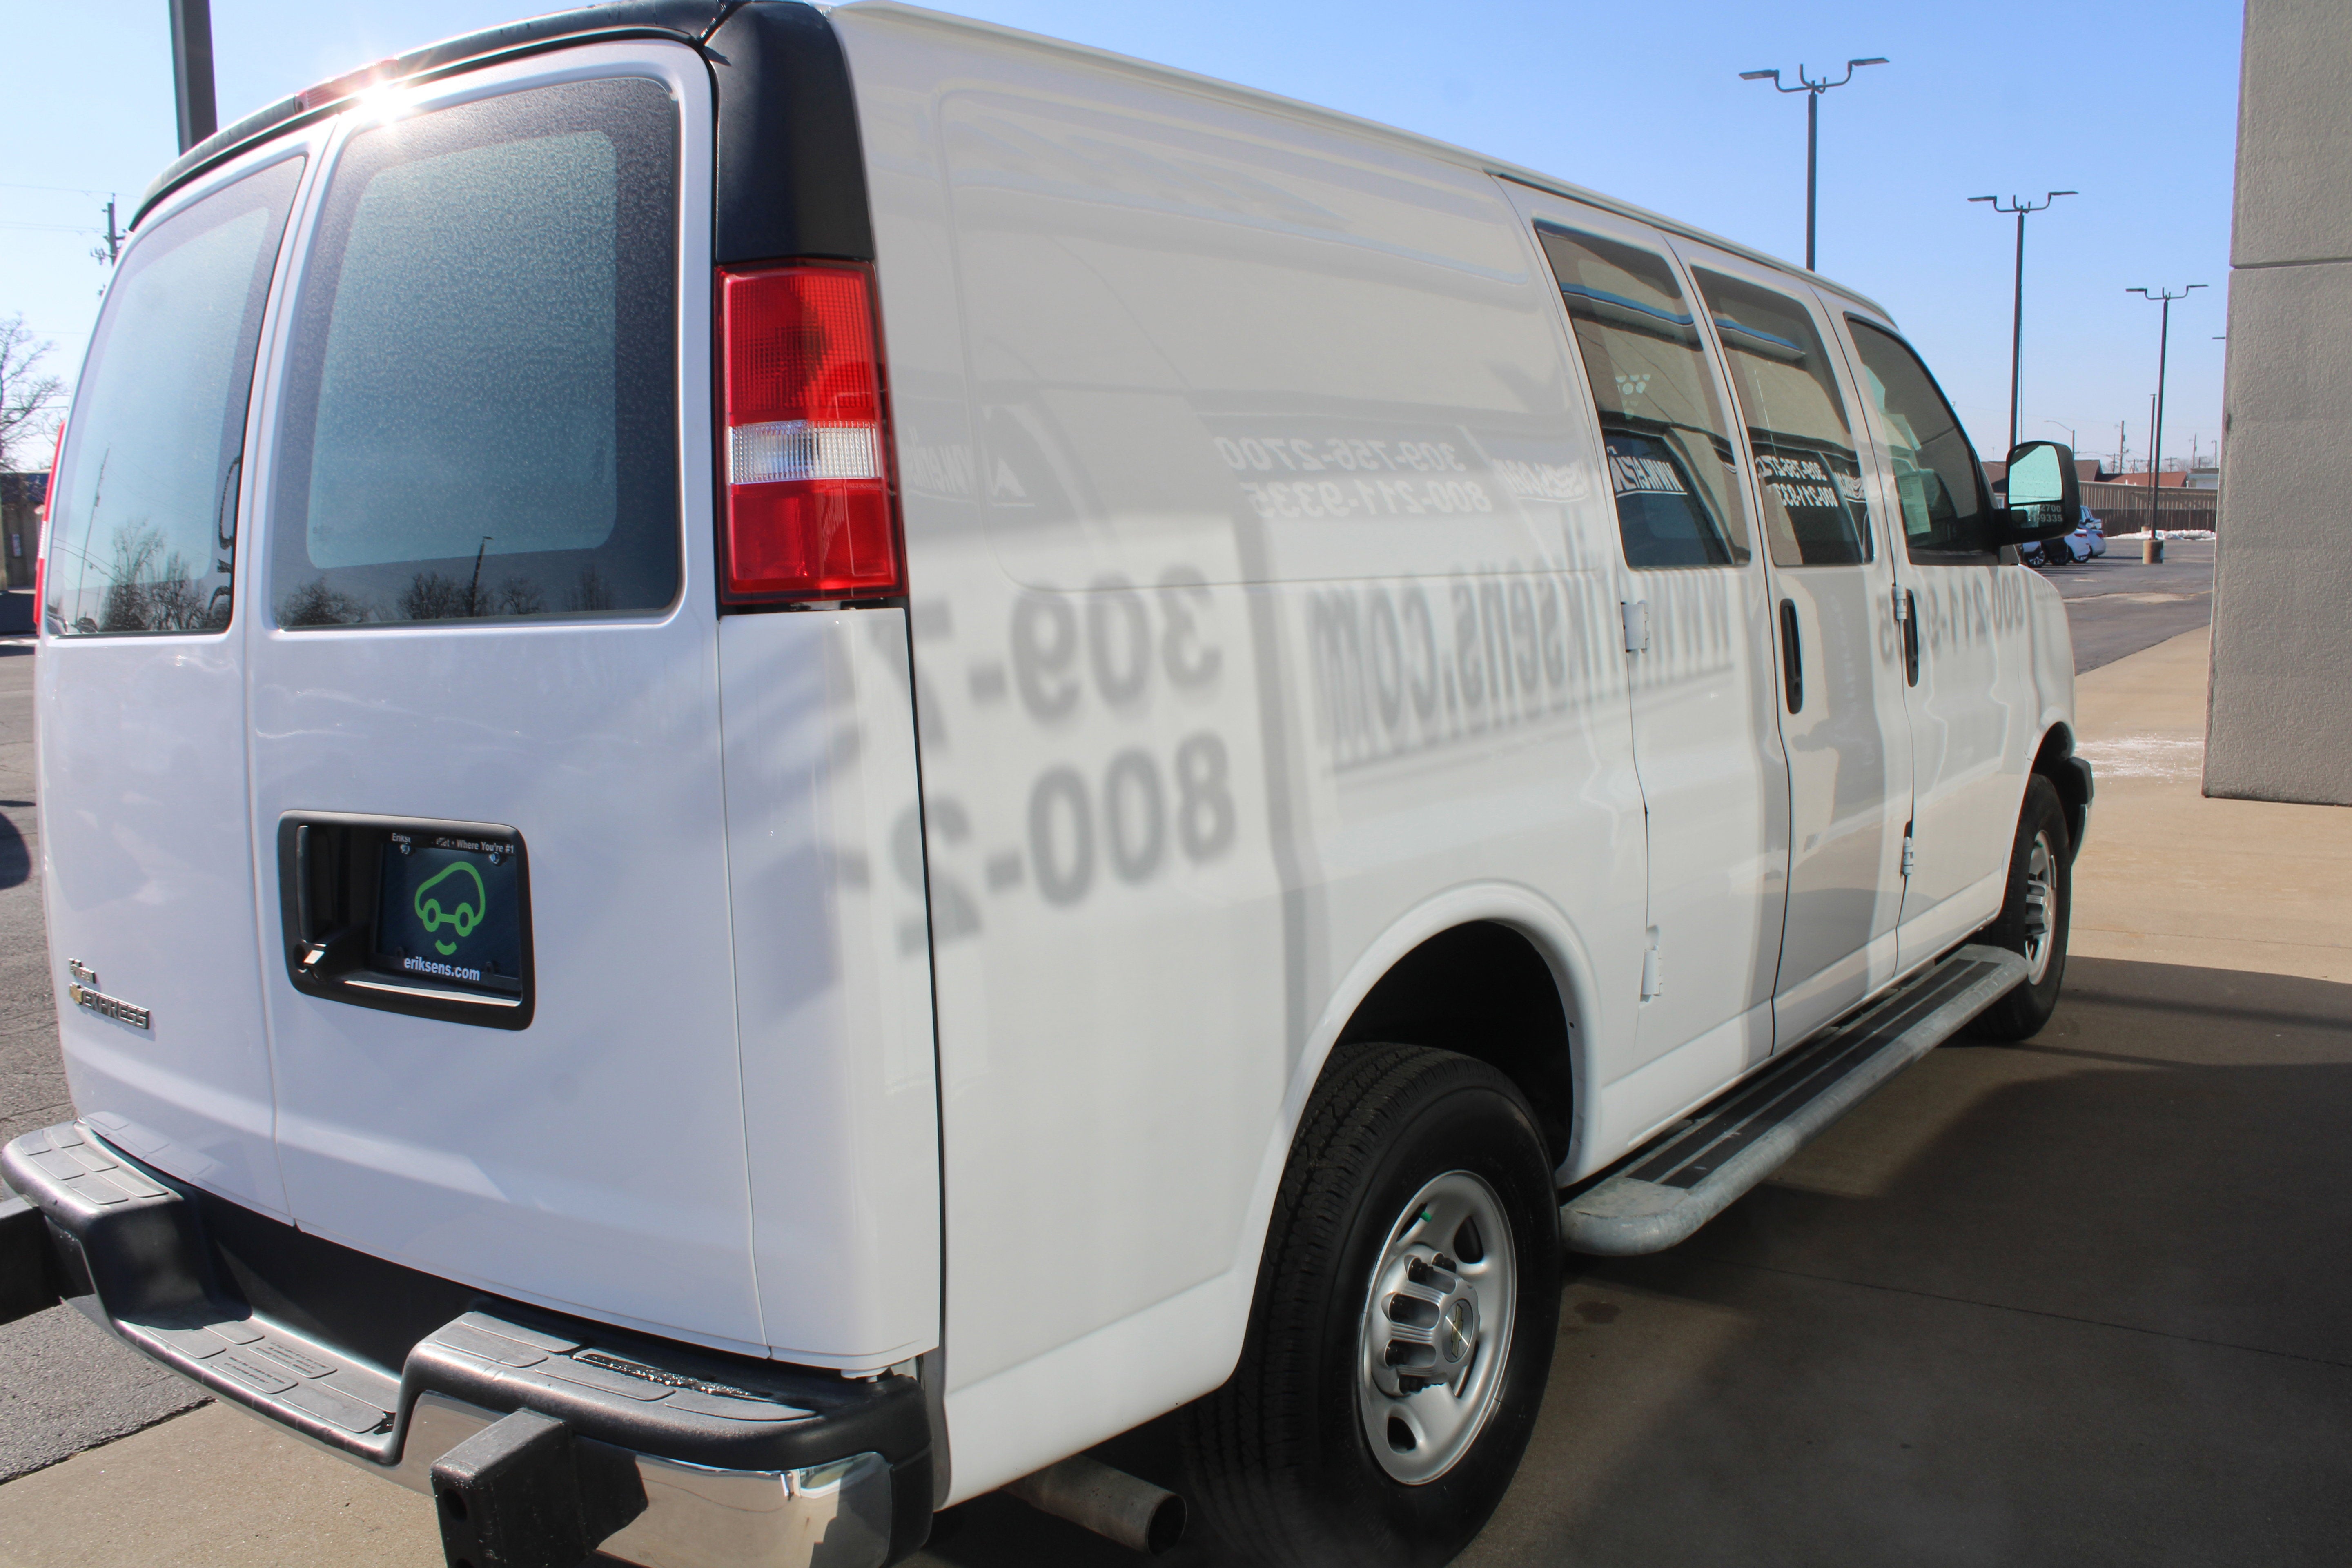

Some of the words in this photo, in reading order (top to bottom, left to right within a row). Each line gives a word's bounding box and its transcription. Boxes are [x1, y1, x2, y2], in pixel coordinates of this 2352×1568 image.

[457, 839, 479, 850] Where
[480, 841, 503, 852] You're
[505, 844, 514, 853] #1
[404, 956, 480, 981] eriksens.com
[82, 987, 149, 1029] EXPRESS
